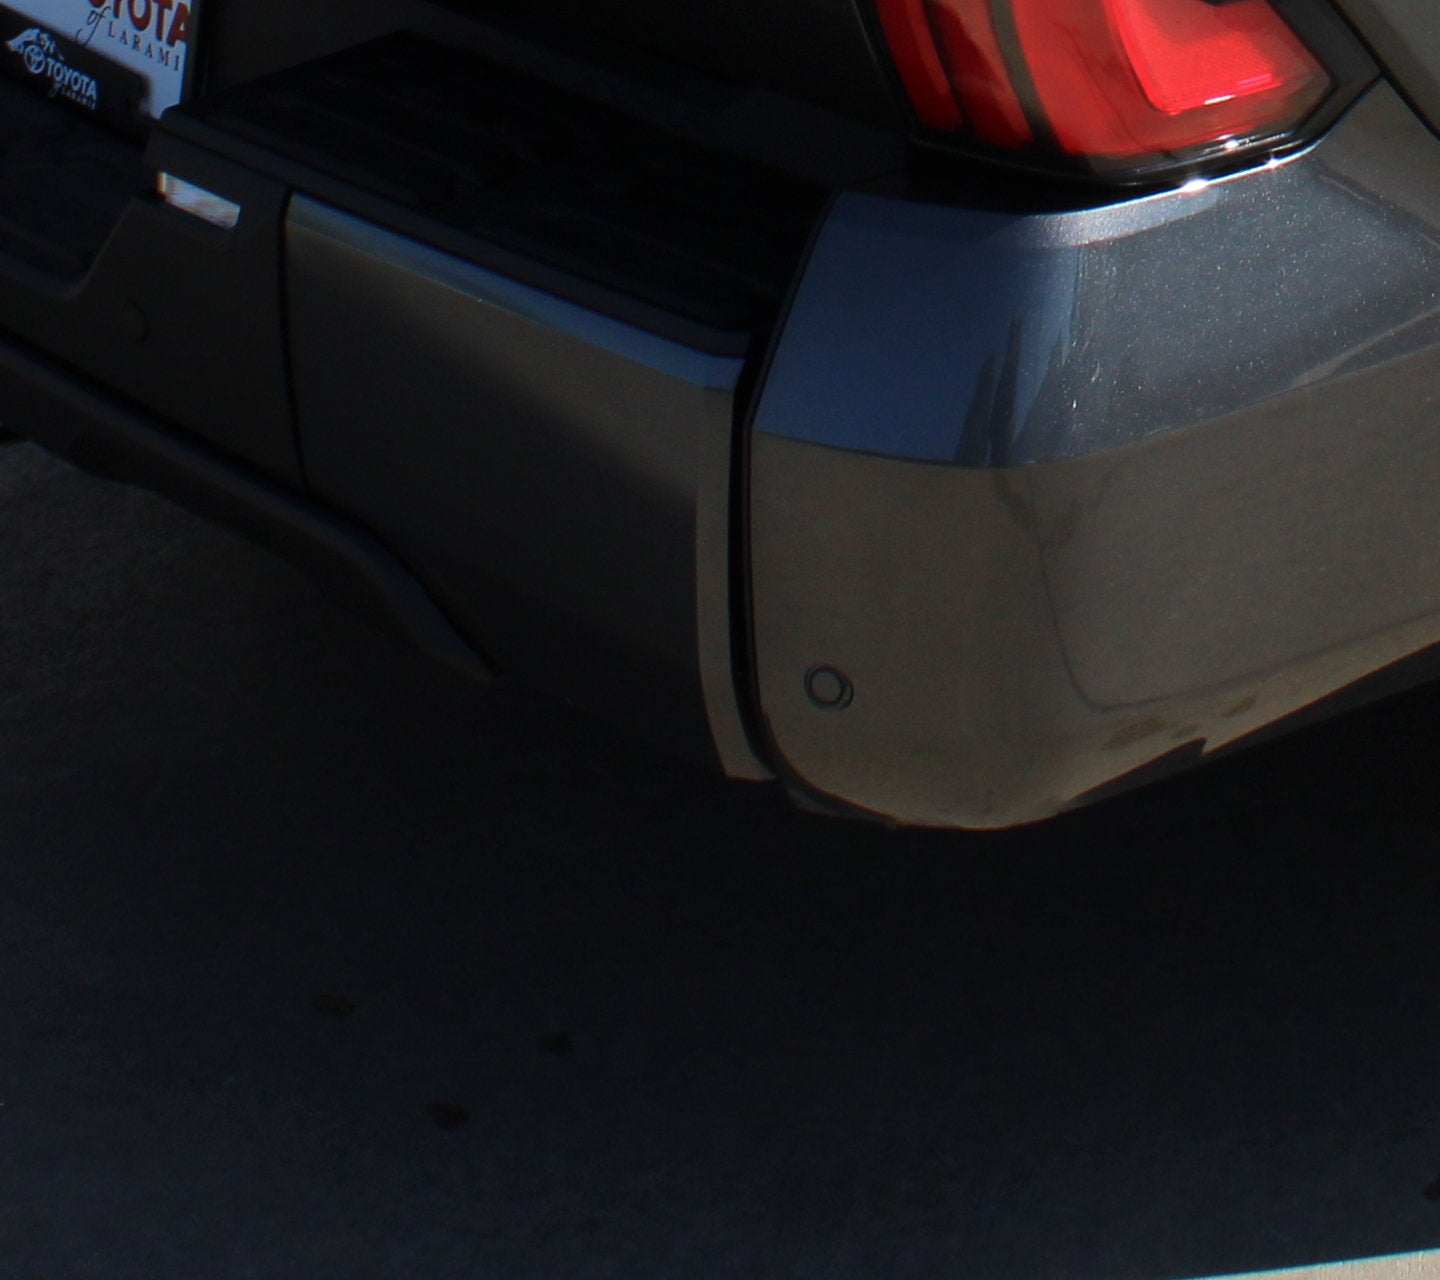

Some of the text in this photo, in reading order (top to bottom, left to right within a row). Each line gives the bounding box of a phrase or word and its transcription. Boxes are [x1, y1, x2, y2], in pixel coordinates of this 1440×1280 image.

[75, 6, 181, 72] of LARAMI
[47, 57, 97, 101] TOYOTA
